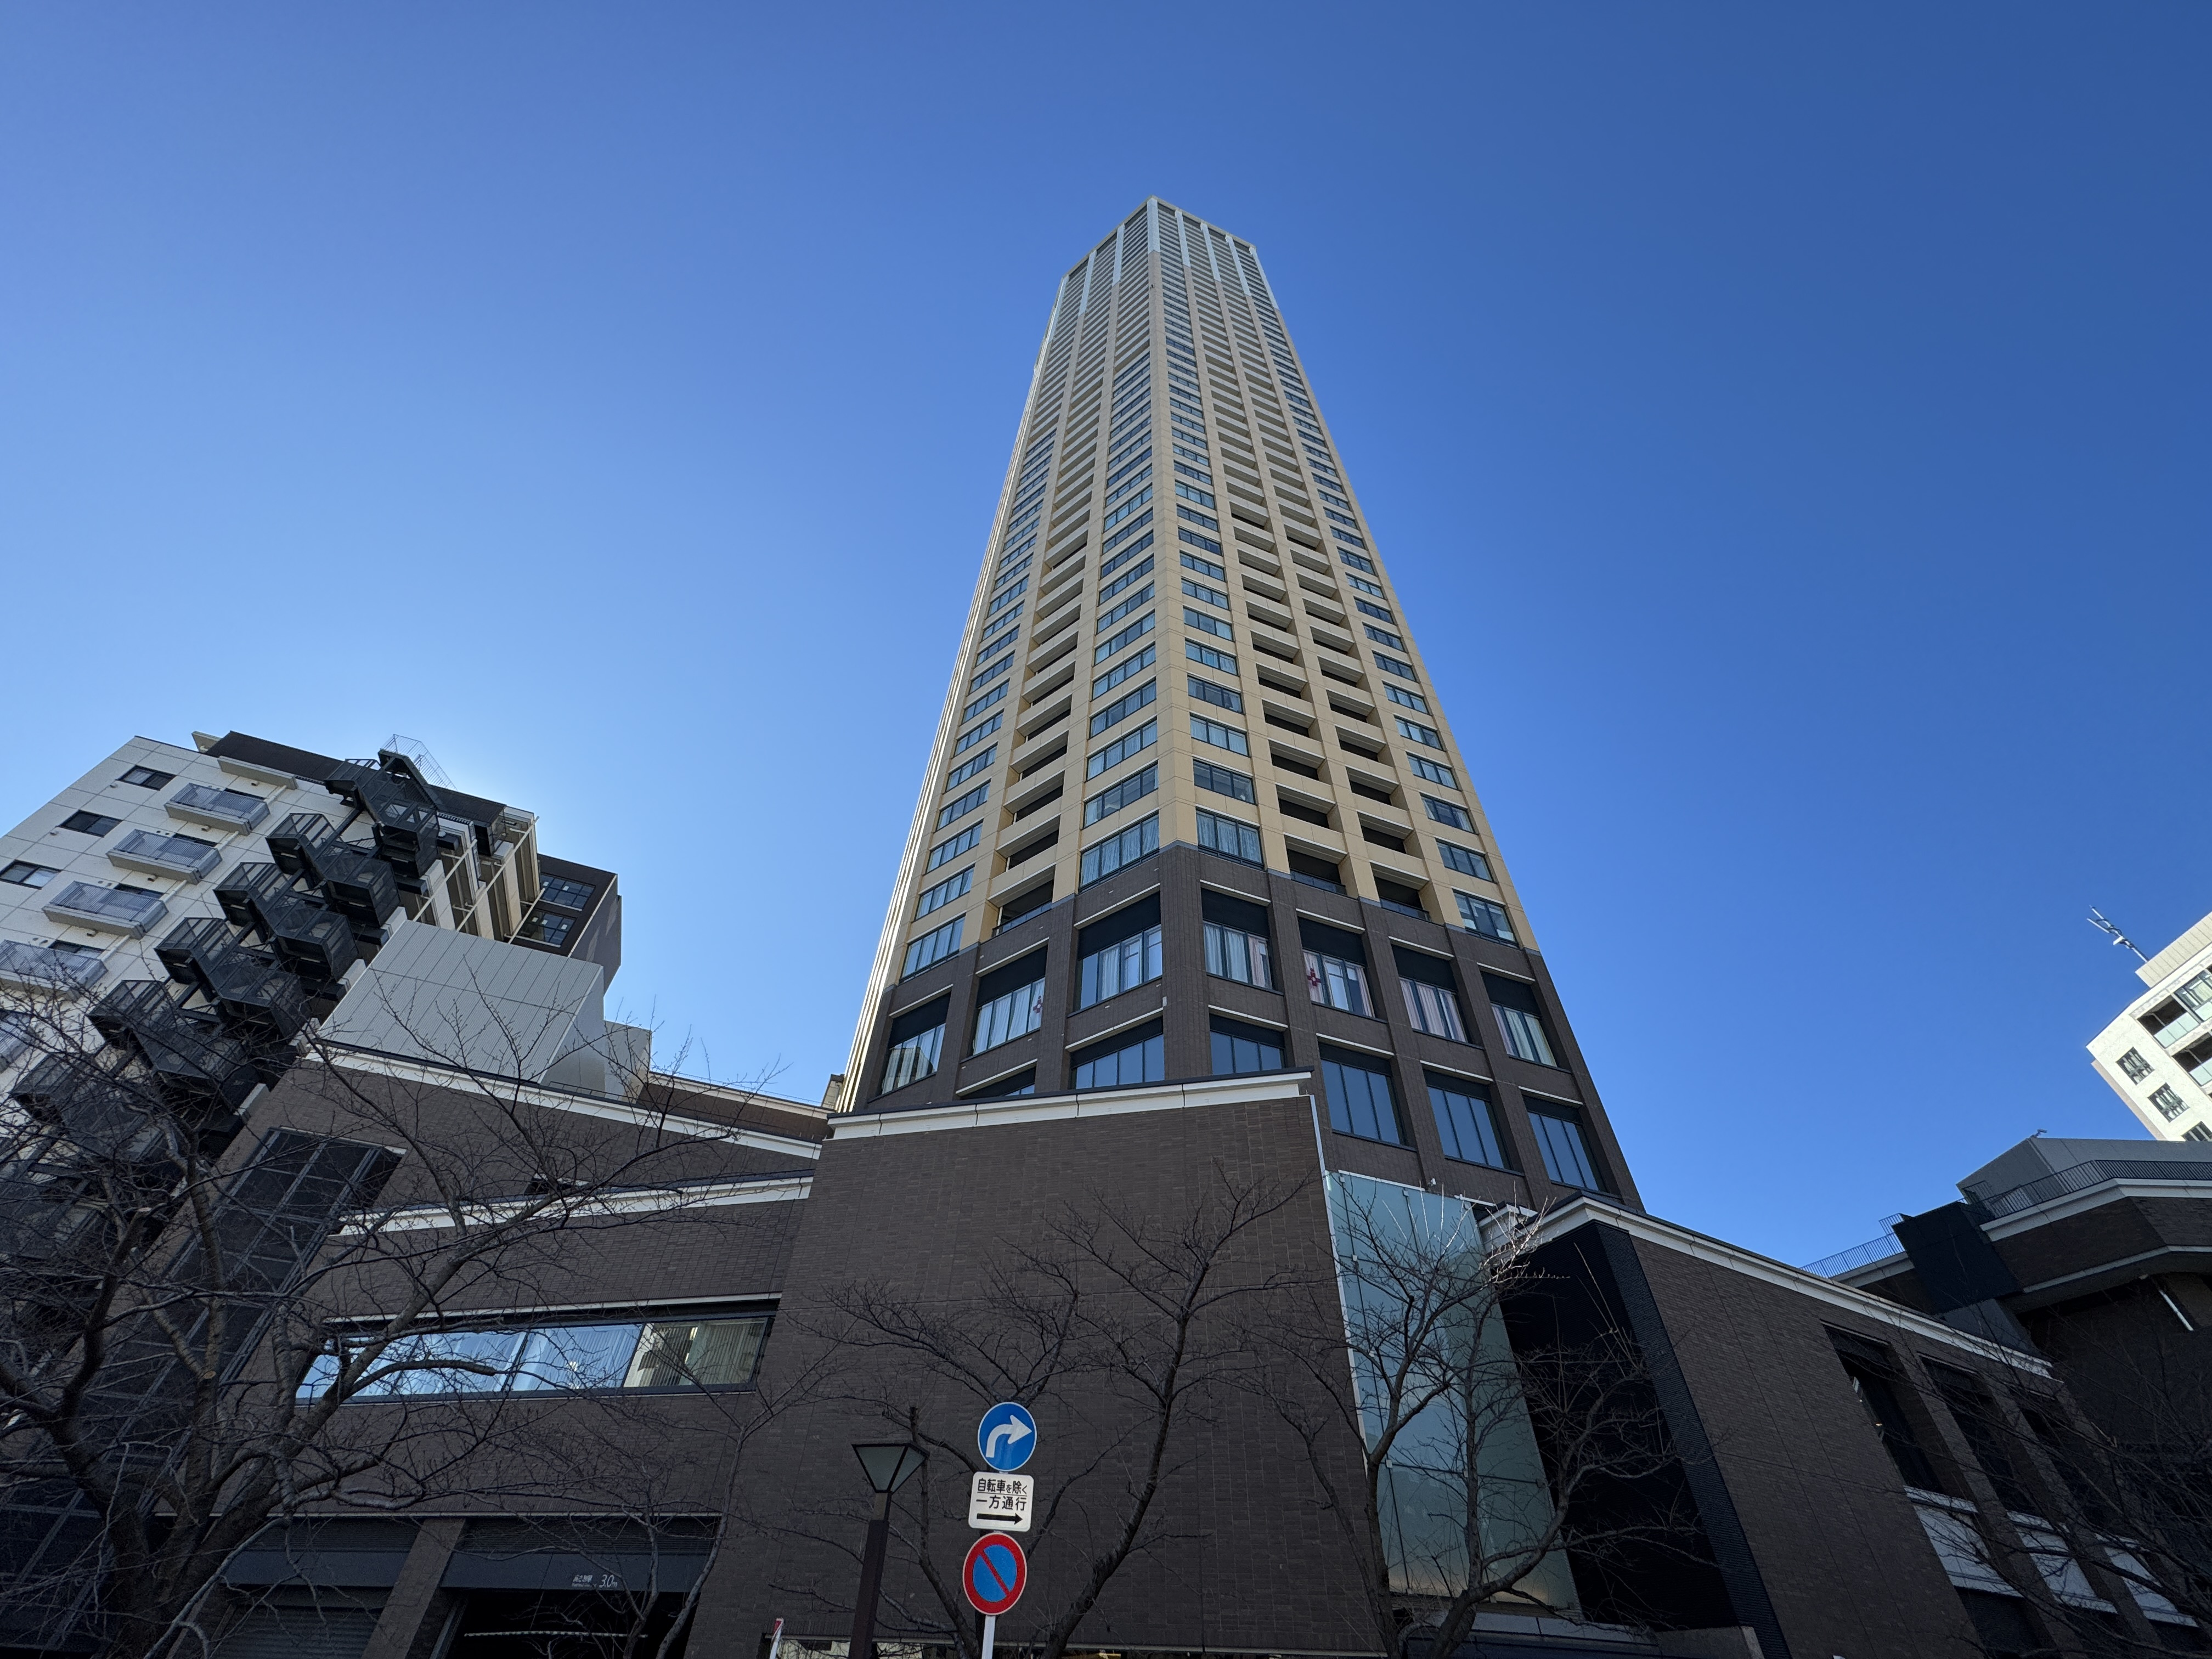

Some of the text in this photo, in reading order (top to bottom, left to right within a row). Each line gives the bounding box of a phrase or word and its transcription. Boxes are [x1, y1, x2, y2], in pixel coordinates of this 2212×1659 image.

[978, 1478, 1028, 1494] 自転車を除く
[977, 1495, 1026, 1511] 一方通行
